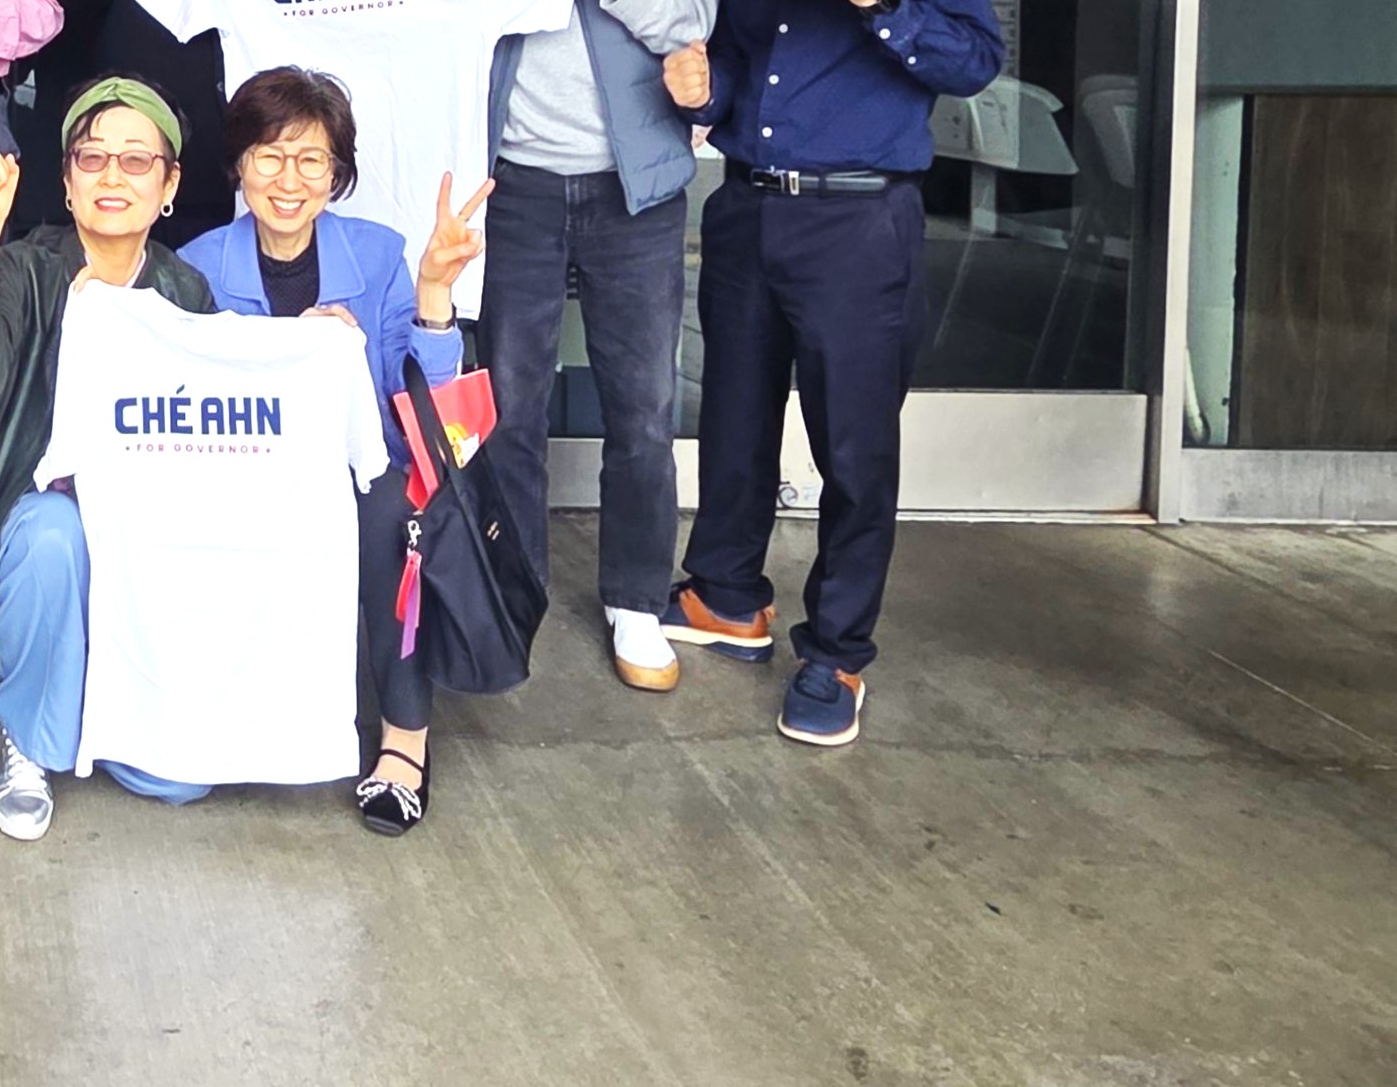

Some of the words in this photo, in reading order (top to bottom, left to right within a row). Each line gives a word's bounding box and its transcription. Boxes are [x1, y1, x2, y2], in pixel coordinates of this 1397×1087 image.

[322, 0, 393, 15] GOVERNOR
[114, 384, 193, 434] CHÉ
[201, 397, 282, 435] AHN
[137, 444, 164, 452] FOR
[174, 444, 259, 454] GOVERNOR
